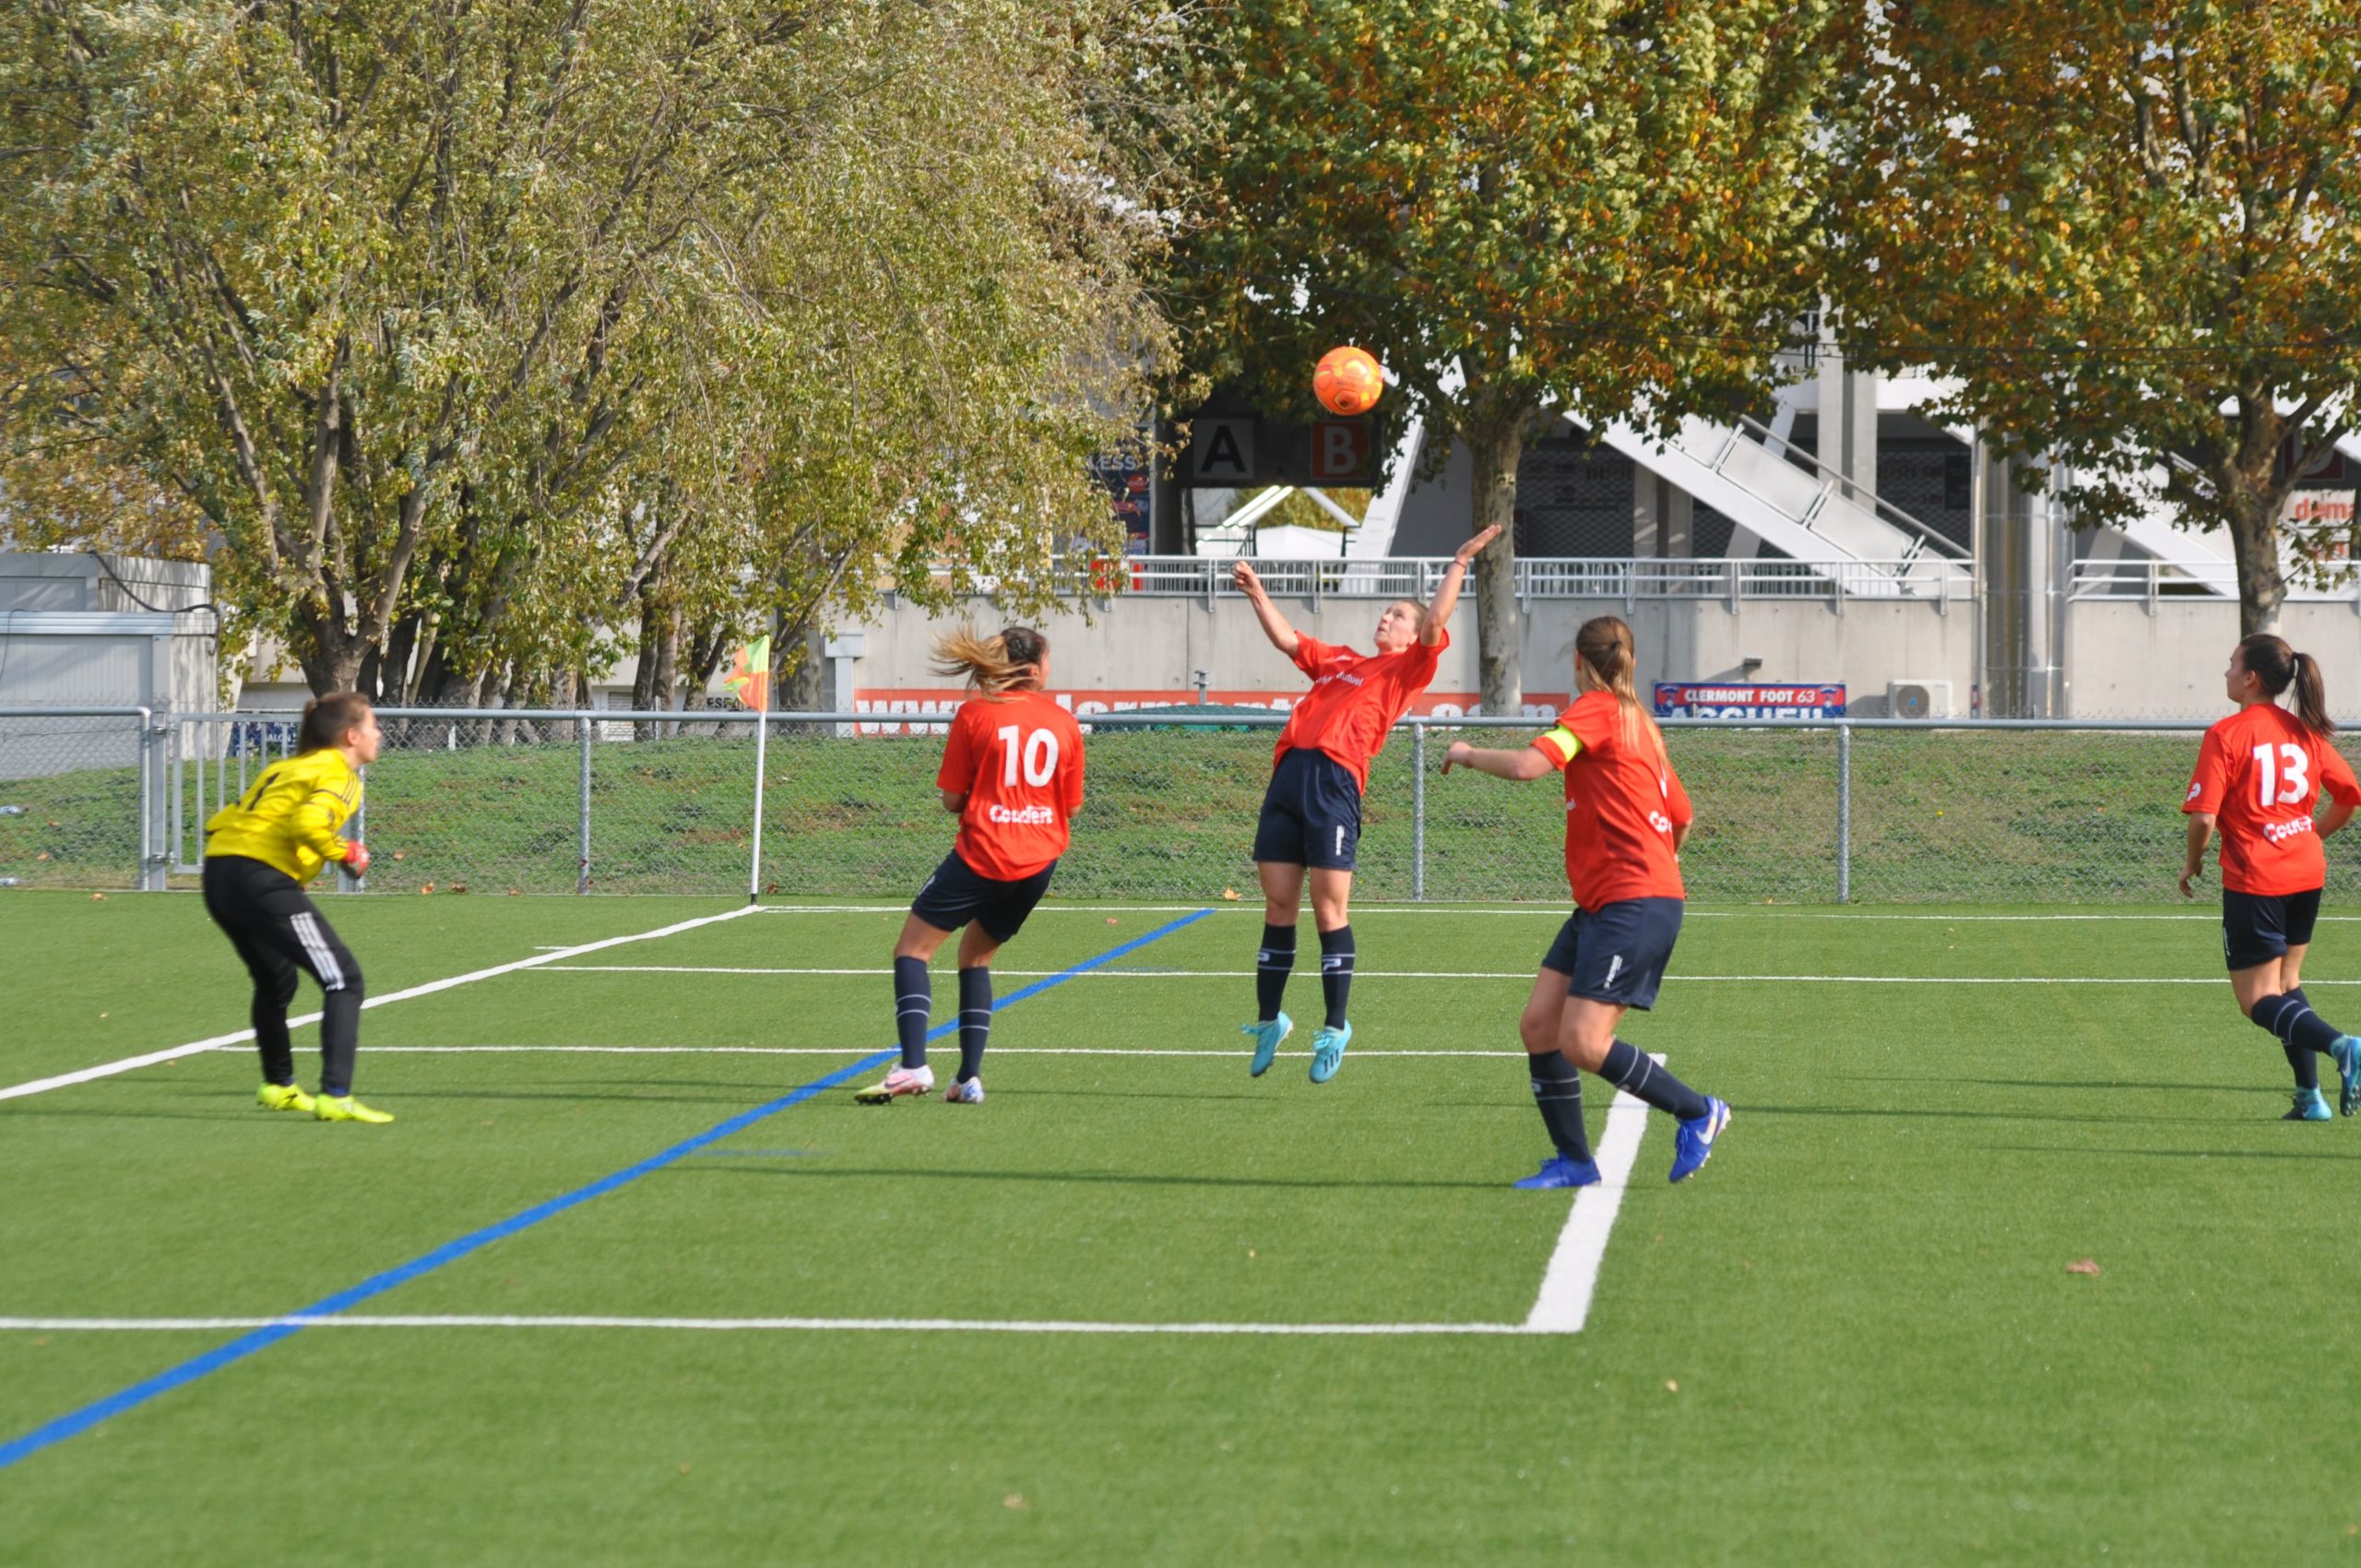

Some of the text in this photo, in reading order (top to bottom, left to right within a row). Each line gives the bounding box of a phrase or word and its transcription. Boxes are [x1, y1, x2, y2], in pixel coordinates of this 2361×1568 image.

[1201, 424, 1247, 472] A
[1323, 425, 1357, 473] B
[1685, 689, 1815, 703] CLERMONT FOOT 63
[998, 725, 1059, 787] 10
[2253, 742, 2308, 807] 13
